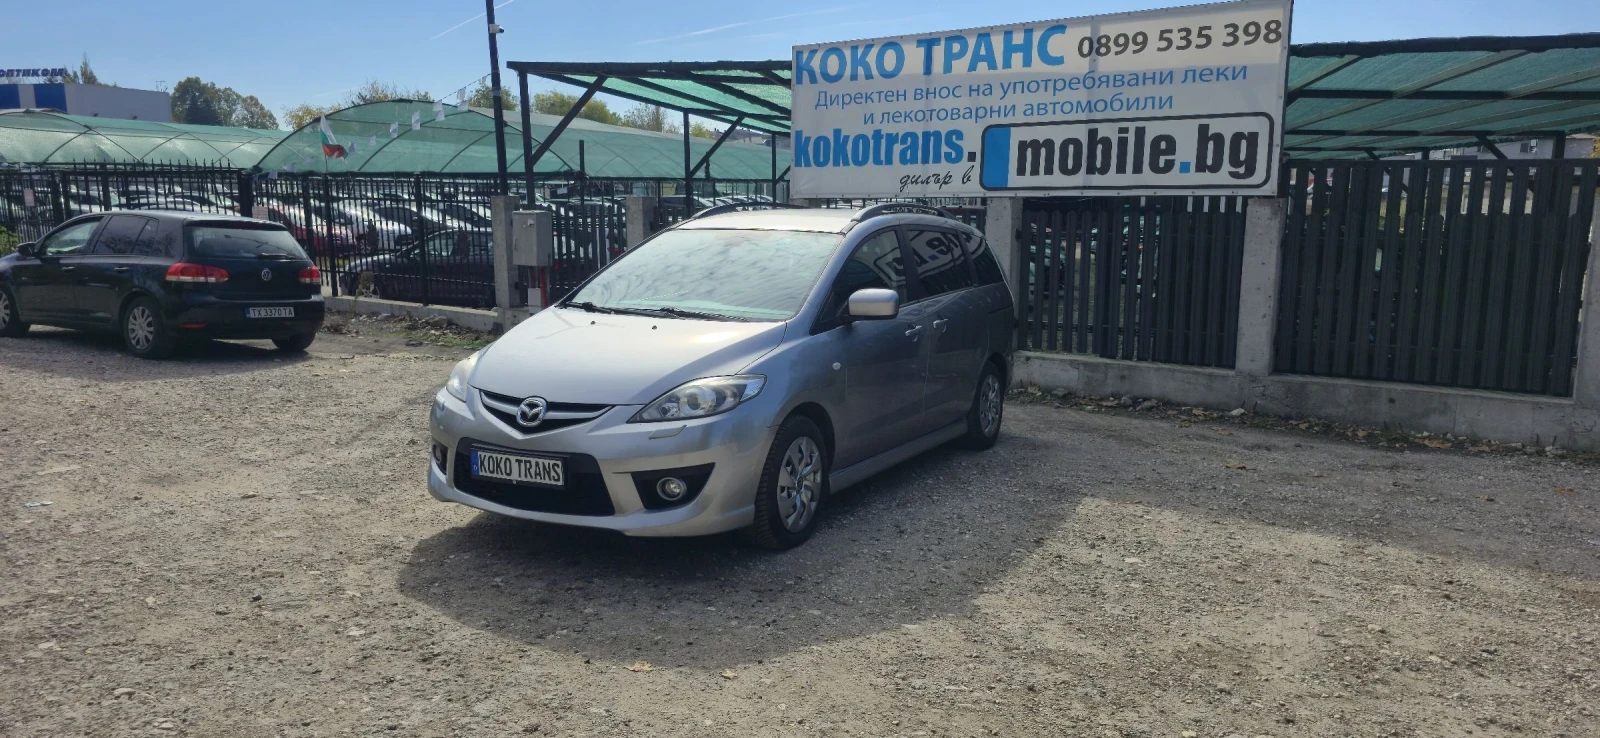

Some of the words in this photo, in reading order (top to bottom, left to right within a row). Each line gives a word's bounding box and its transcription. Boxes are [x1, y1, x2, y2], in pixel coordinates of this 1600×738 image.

[795, 41, 906, 85] КОКО
[916, 24, 1068, 76] ТРАНС
[1077, 31, 1149, 58] 0899
[1156, 25, 1213, 52] 535
[1222, 19, 1282, 48] 398
[815, 88, 907, 110] Директен
[913, 83, 962, 101] внос
[968, 81, 993, 98] на
[1000, 69, 1174, 99] употребявани
[1181, 65, 1248, 84] леки
[863, 112, 875, 126] и
[879, 103, 1017, 124] лекотоварни
[1023, 92, 1174, 117] автомобили
[1016, 123, 1260, 180] mobile.bg
[900, 170, 953, 192] дилър
[263, 308, 282, 317] 3370
[479, 454, 512, 477] KOKO
[515, 458, 561, 482] TRANS
